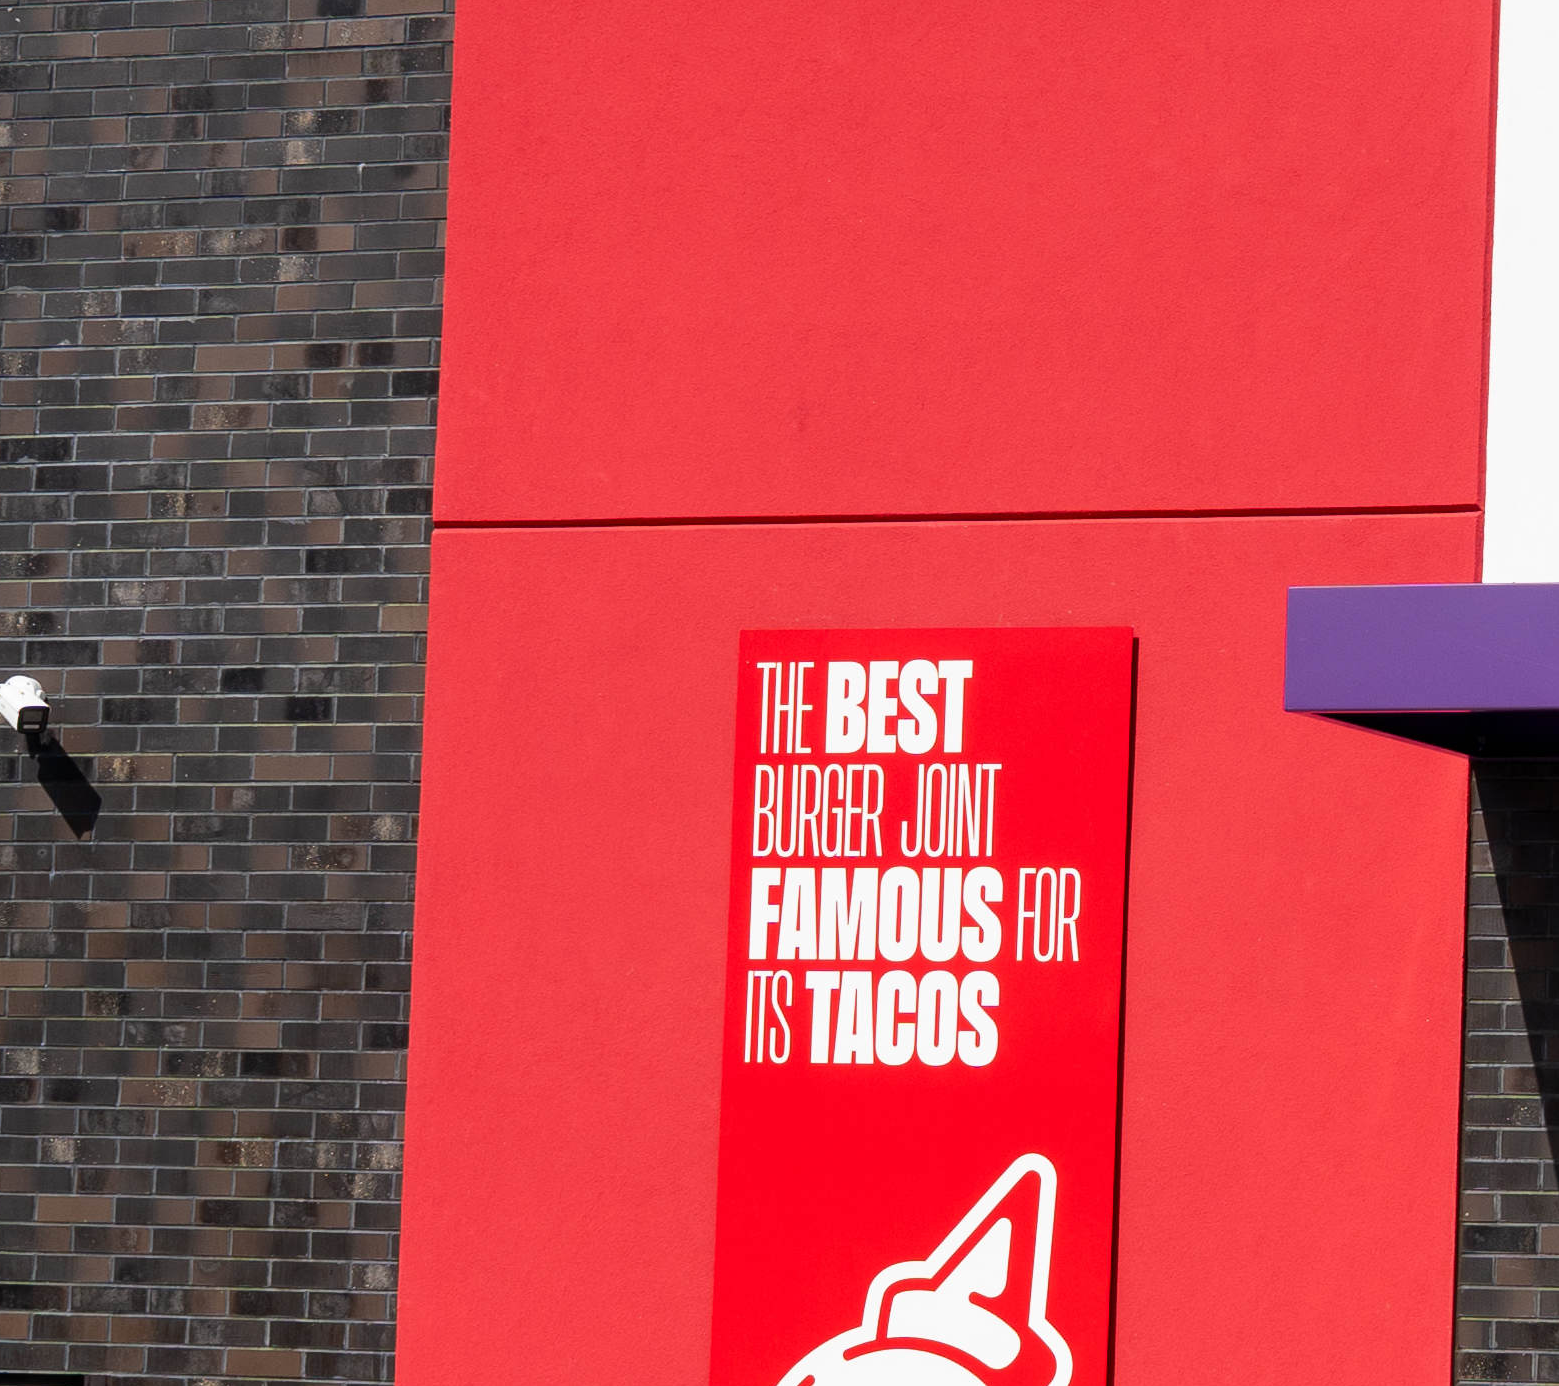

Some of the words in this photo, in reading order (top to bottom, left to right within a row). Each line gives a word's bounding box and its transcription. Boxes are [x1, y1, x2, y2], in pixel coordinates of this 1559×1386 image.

[757, 661, 814, 753] THE
[825, 659, 973, 754] BEST
[752, 764, 884, 857] BURGER
[901, 763, 1002, 857] JOINT
[748, 866, 1003, 962] FAMOUS
[1016, 867, 1082, 961] FOR
[744, 970, 793, 1063] ITS
[806, 970, 1000, 1066] TACOS
